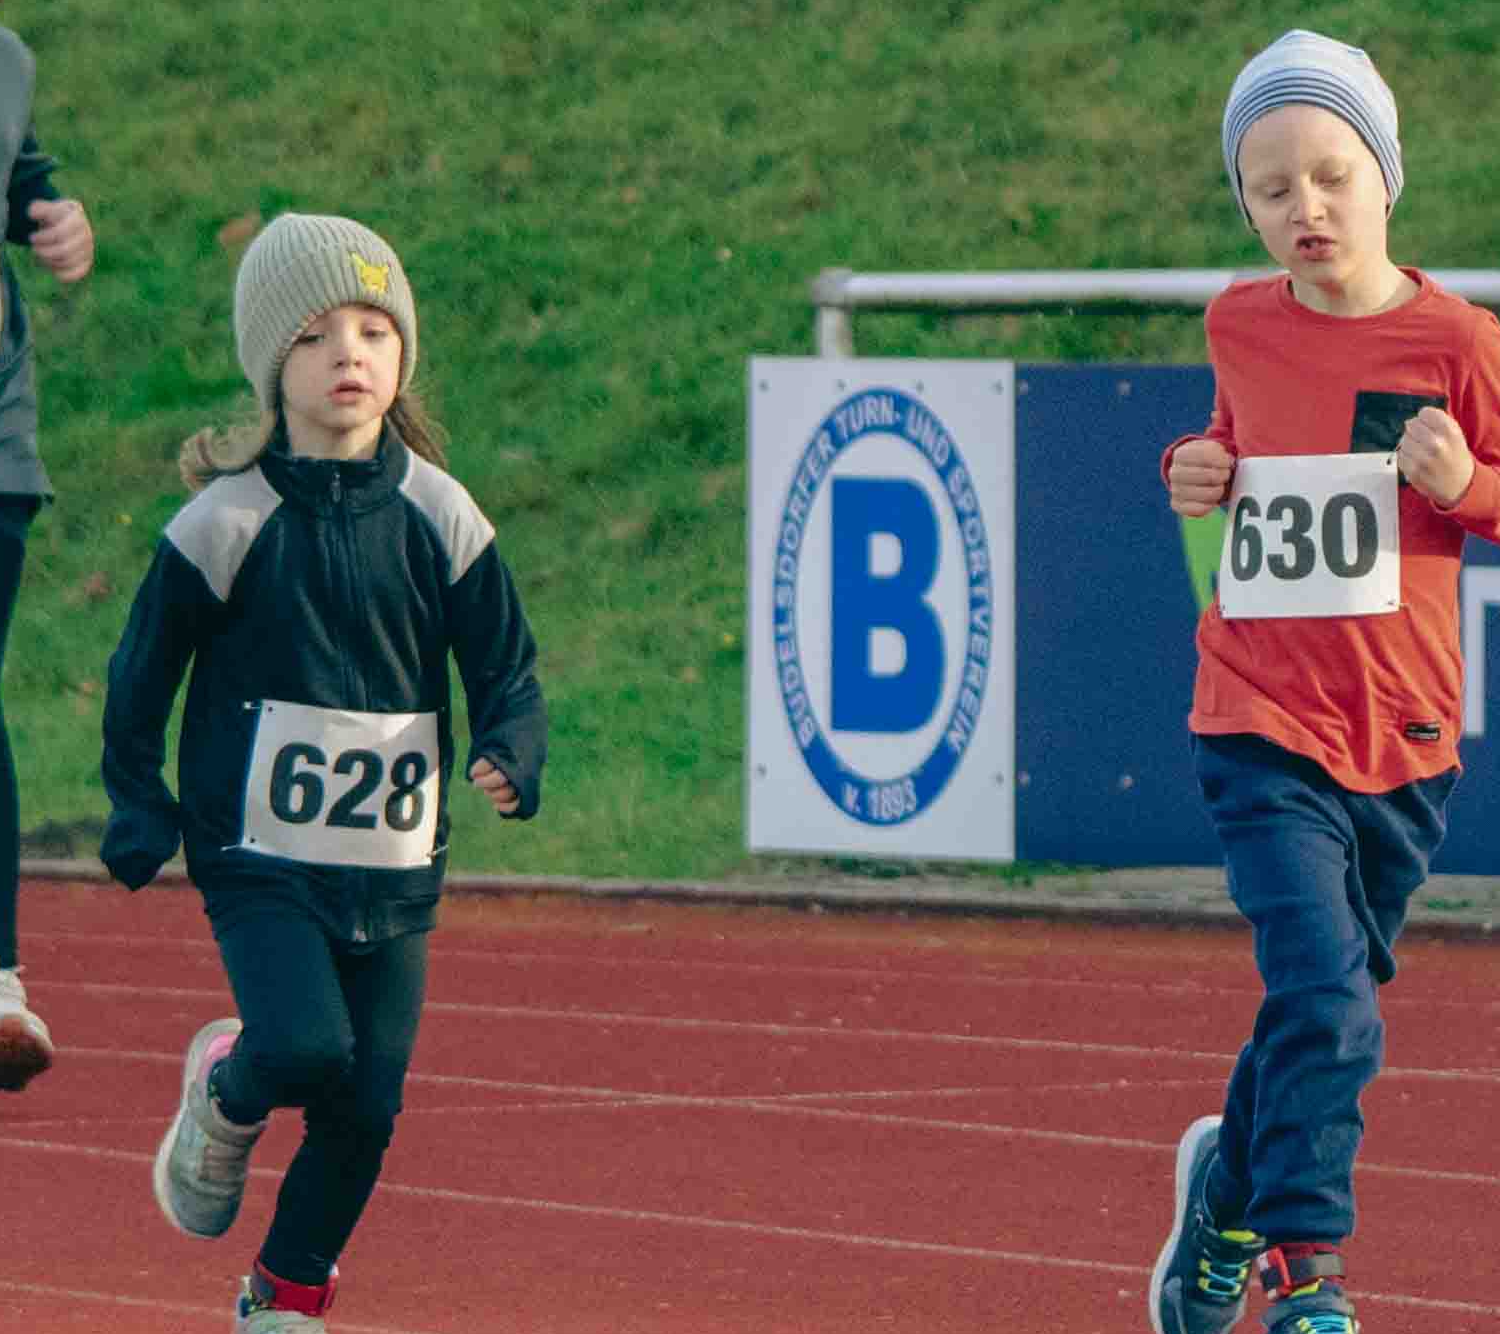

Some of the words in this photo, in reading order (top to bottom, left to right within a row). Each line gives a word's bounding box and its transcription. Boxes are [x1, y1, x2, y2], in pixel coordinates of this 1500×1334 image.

[831, 477, 946, 733] B
[906, 405, 950, 467] UND
[947, 464, 991, 754] SPORTVEREIN
[1230, 492, 1379, 582] 630
[269, 742, 428, 832] 628
